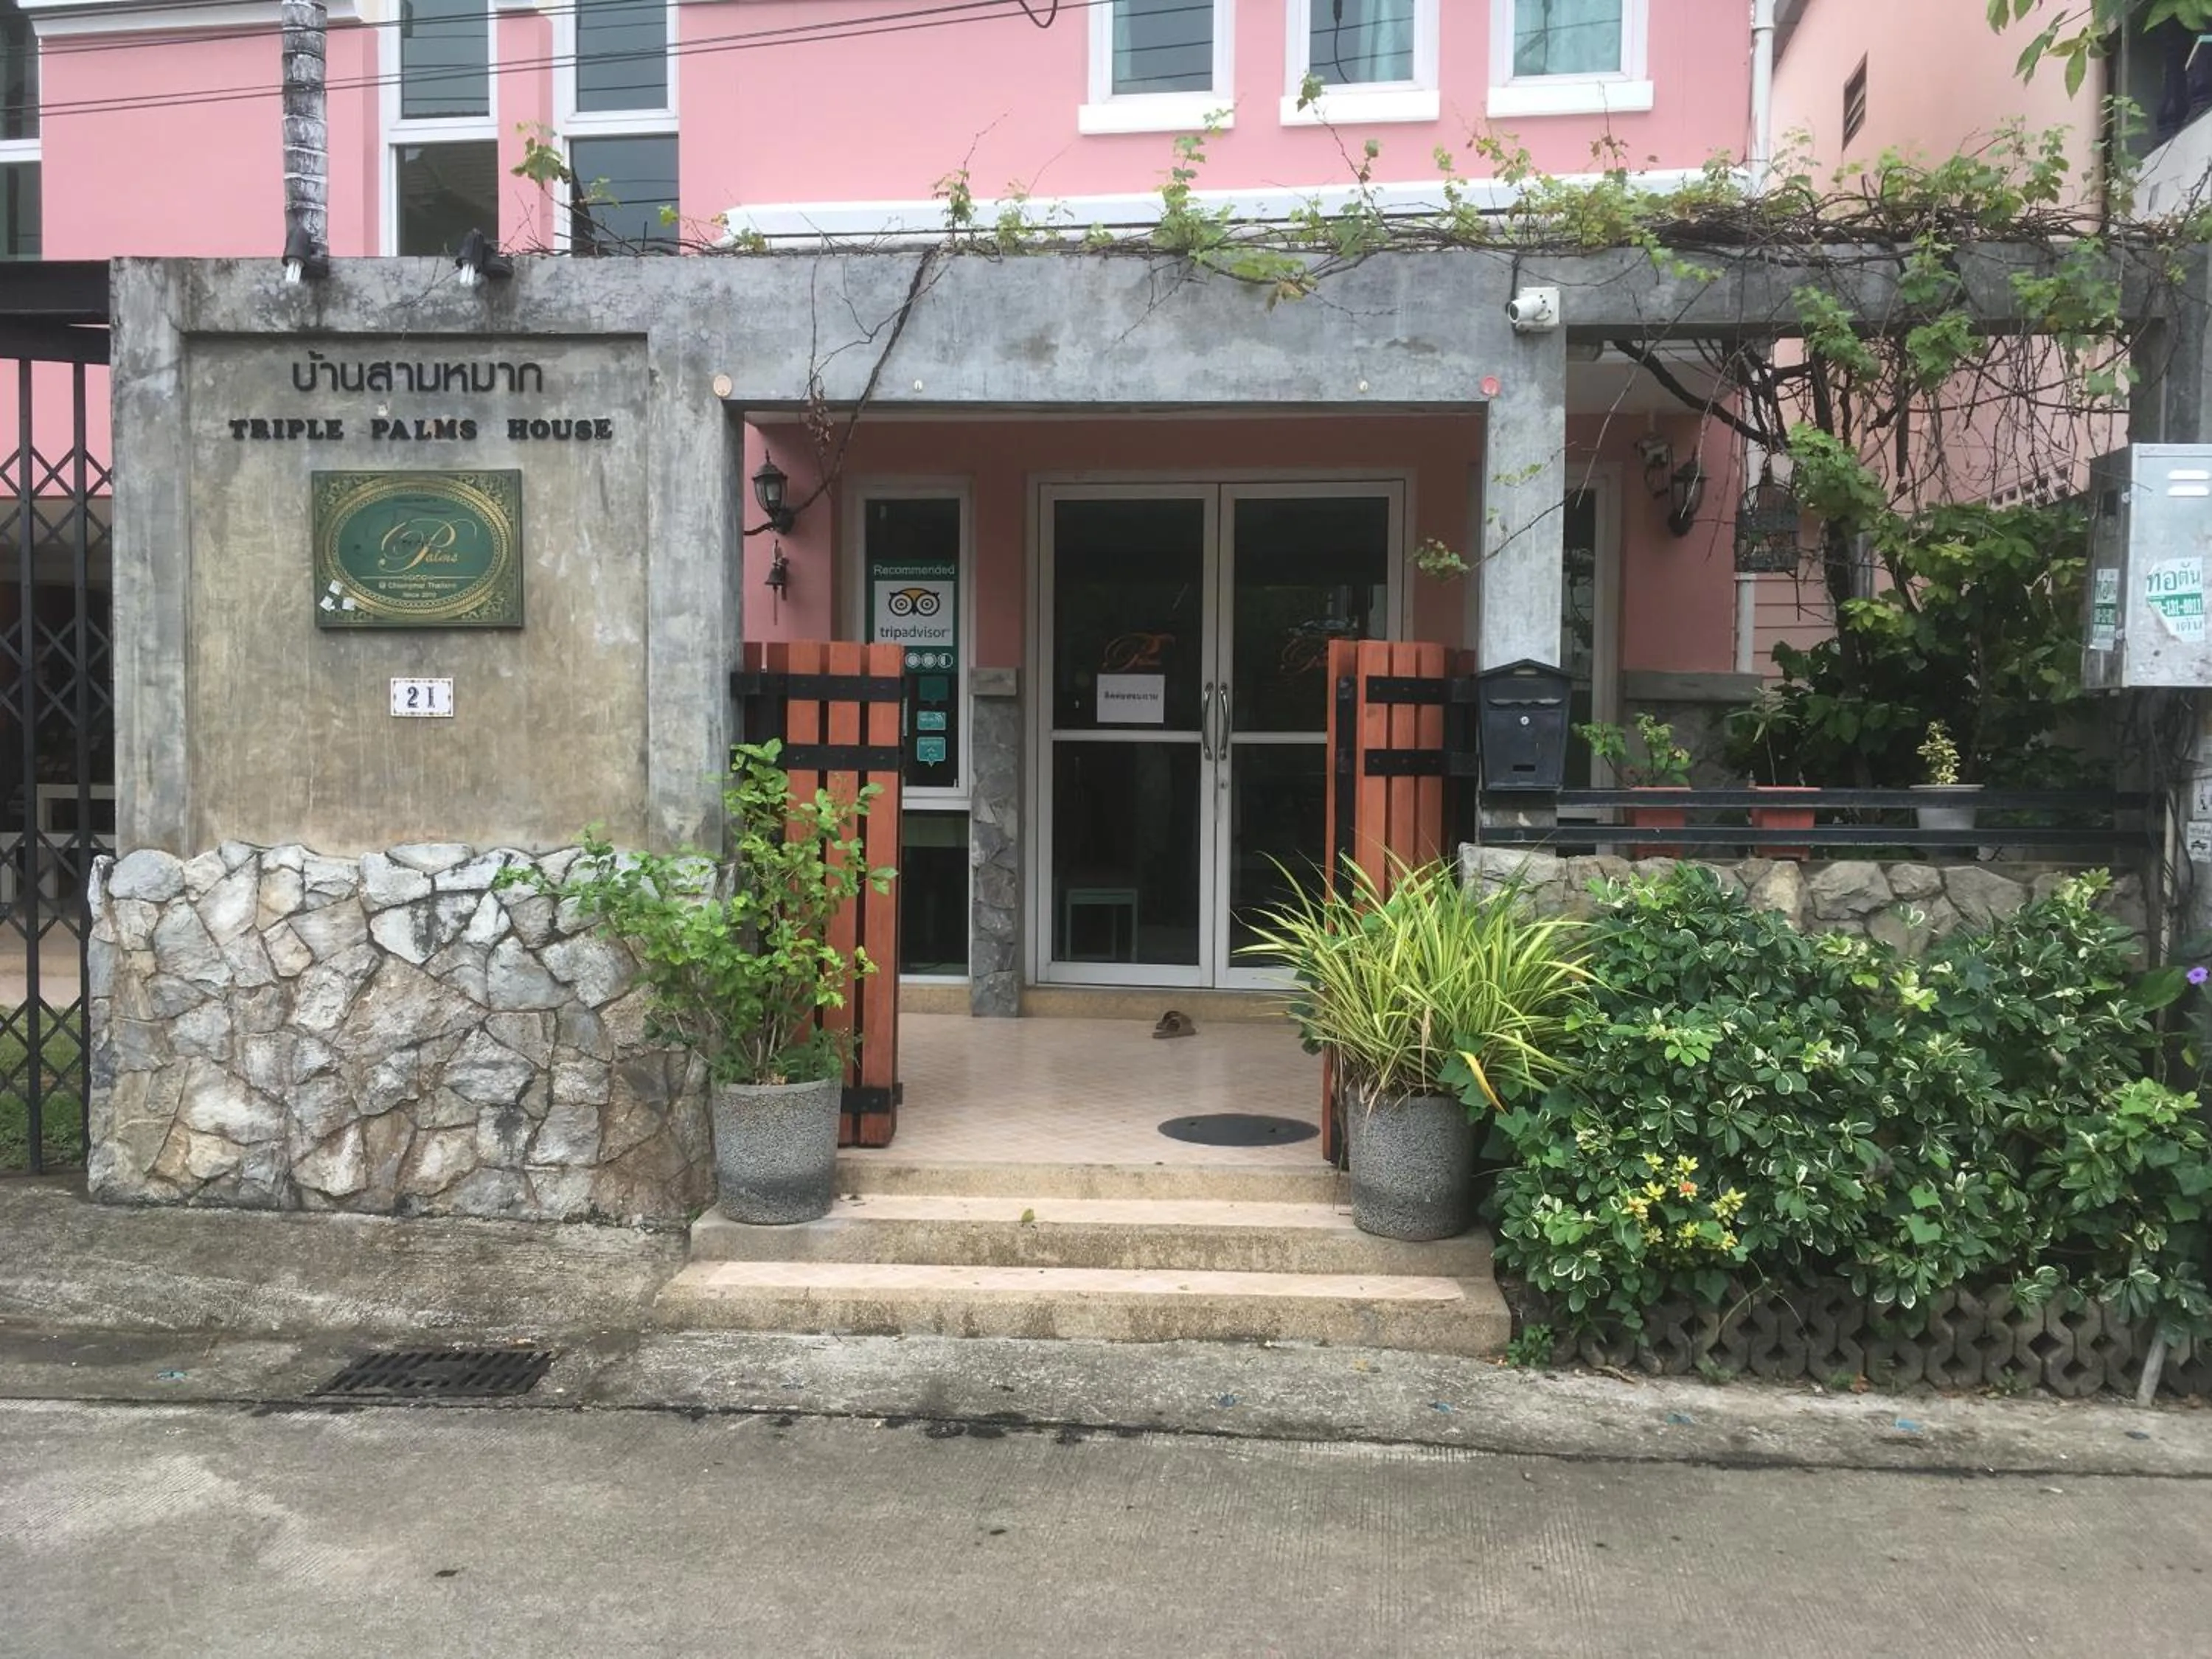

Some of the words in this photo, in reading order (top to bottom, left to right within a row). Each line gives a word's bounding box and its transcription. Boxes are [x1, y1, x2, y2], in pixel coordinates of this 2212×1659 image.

[293, 350, 542, 392] บ้านสามหมาก
[229, 419, 344, 440] TRIPLE
[371, 419, 478, 440] PALMS
[507, 418, 613, 441] HOUSE
[874, 564, 955, 575] Recommended
[880, 625, 947, 641] tripadvisor
[407, 686, 436, 709] 21
